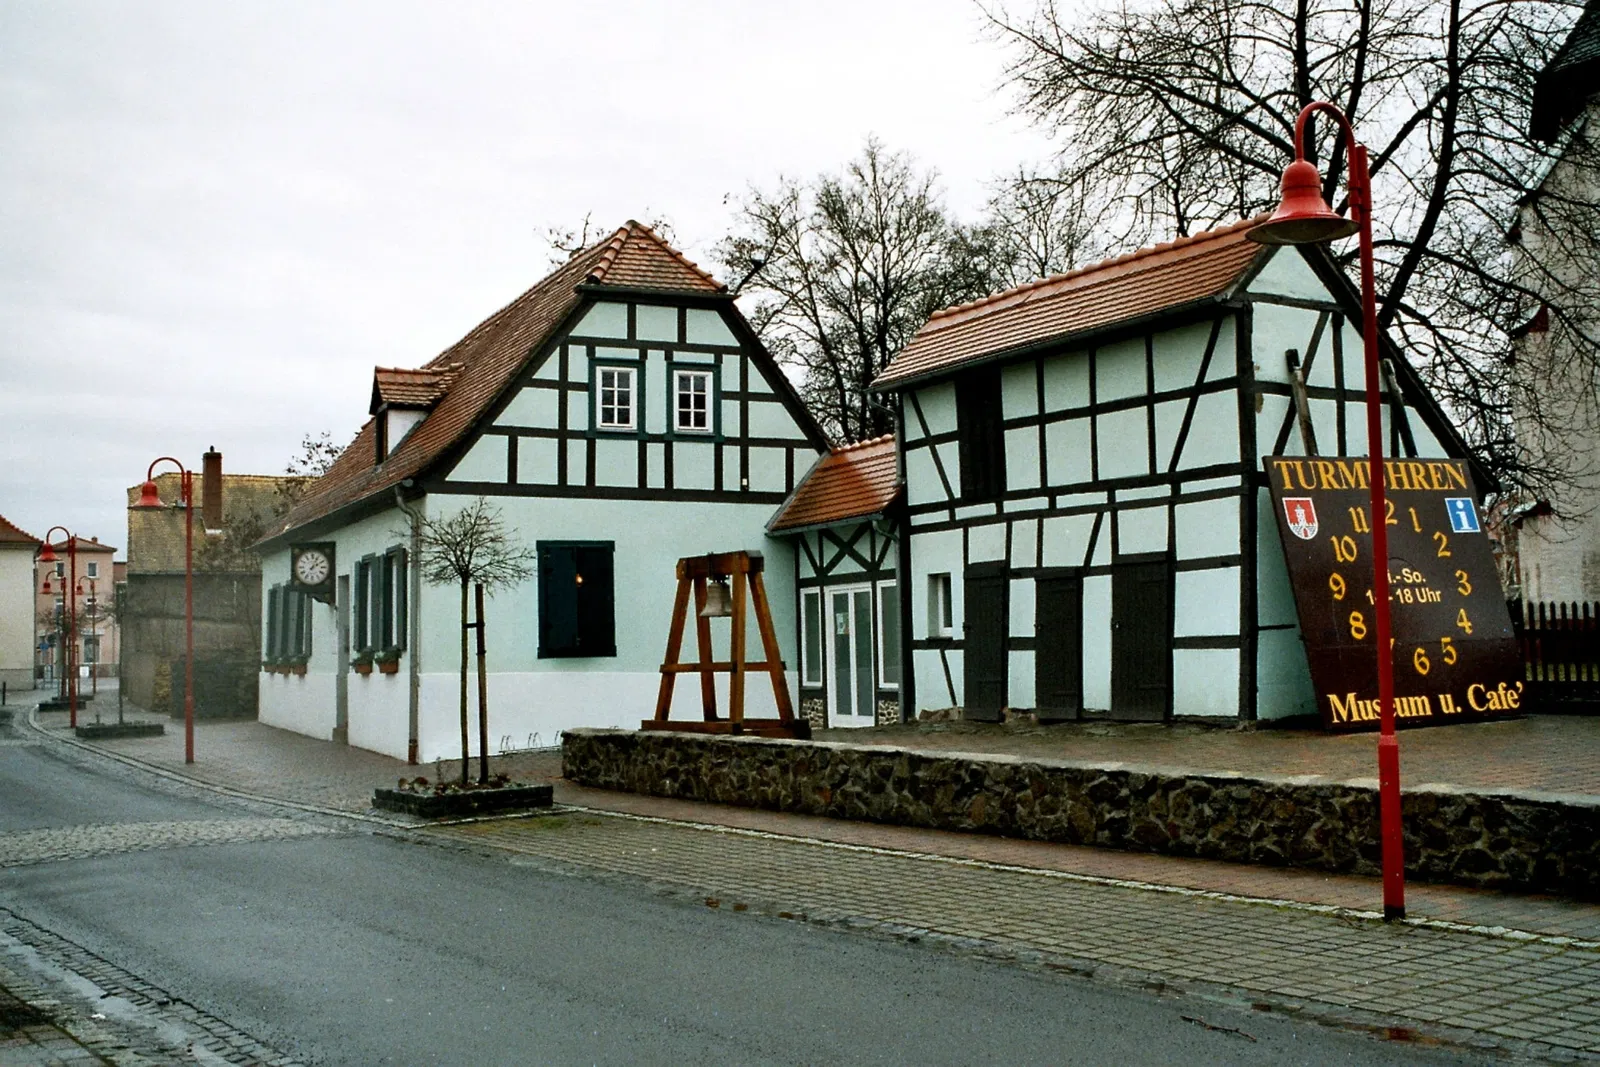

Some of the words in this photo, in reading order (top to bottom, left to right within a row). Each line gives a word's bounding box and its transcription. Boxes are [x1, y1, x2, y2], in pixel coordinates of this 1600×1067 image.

[1274, 460, 1468, 490] TURMHREN
[1409, 507, 1422, 533] 1
[1330, 535, 1358, 563] 10
[1433, 531, 1451, 558] 2
[1329, 572, 1346, 600] 9
[1396, 588, 1413, 604] 18
[1415, 588, 1441, 603] Uhr
[1455, 570, 1472, 596] 3
[1349, 611, 1367, 639] 8
[1456, 608, 1473, 634] 4
[1414, 647, 1430, 675] 6
[1441, 637, 1457, 665] 5
[1327, 692, 1432, 723] Musum
[1439, 693, 1462, 714] u.
